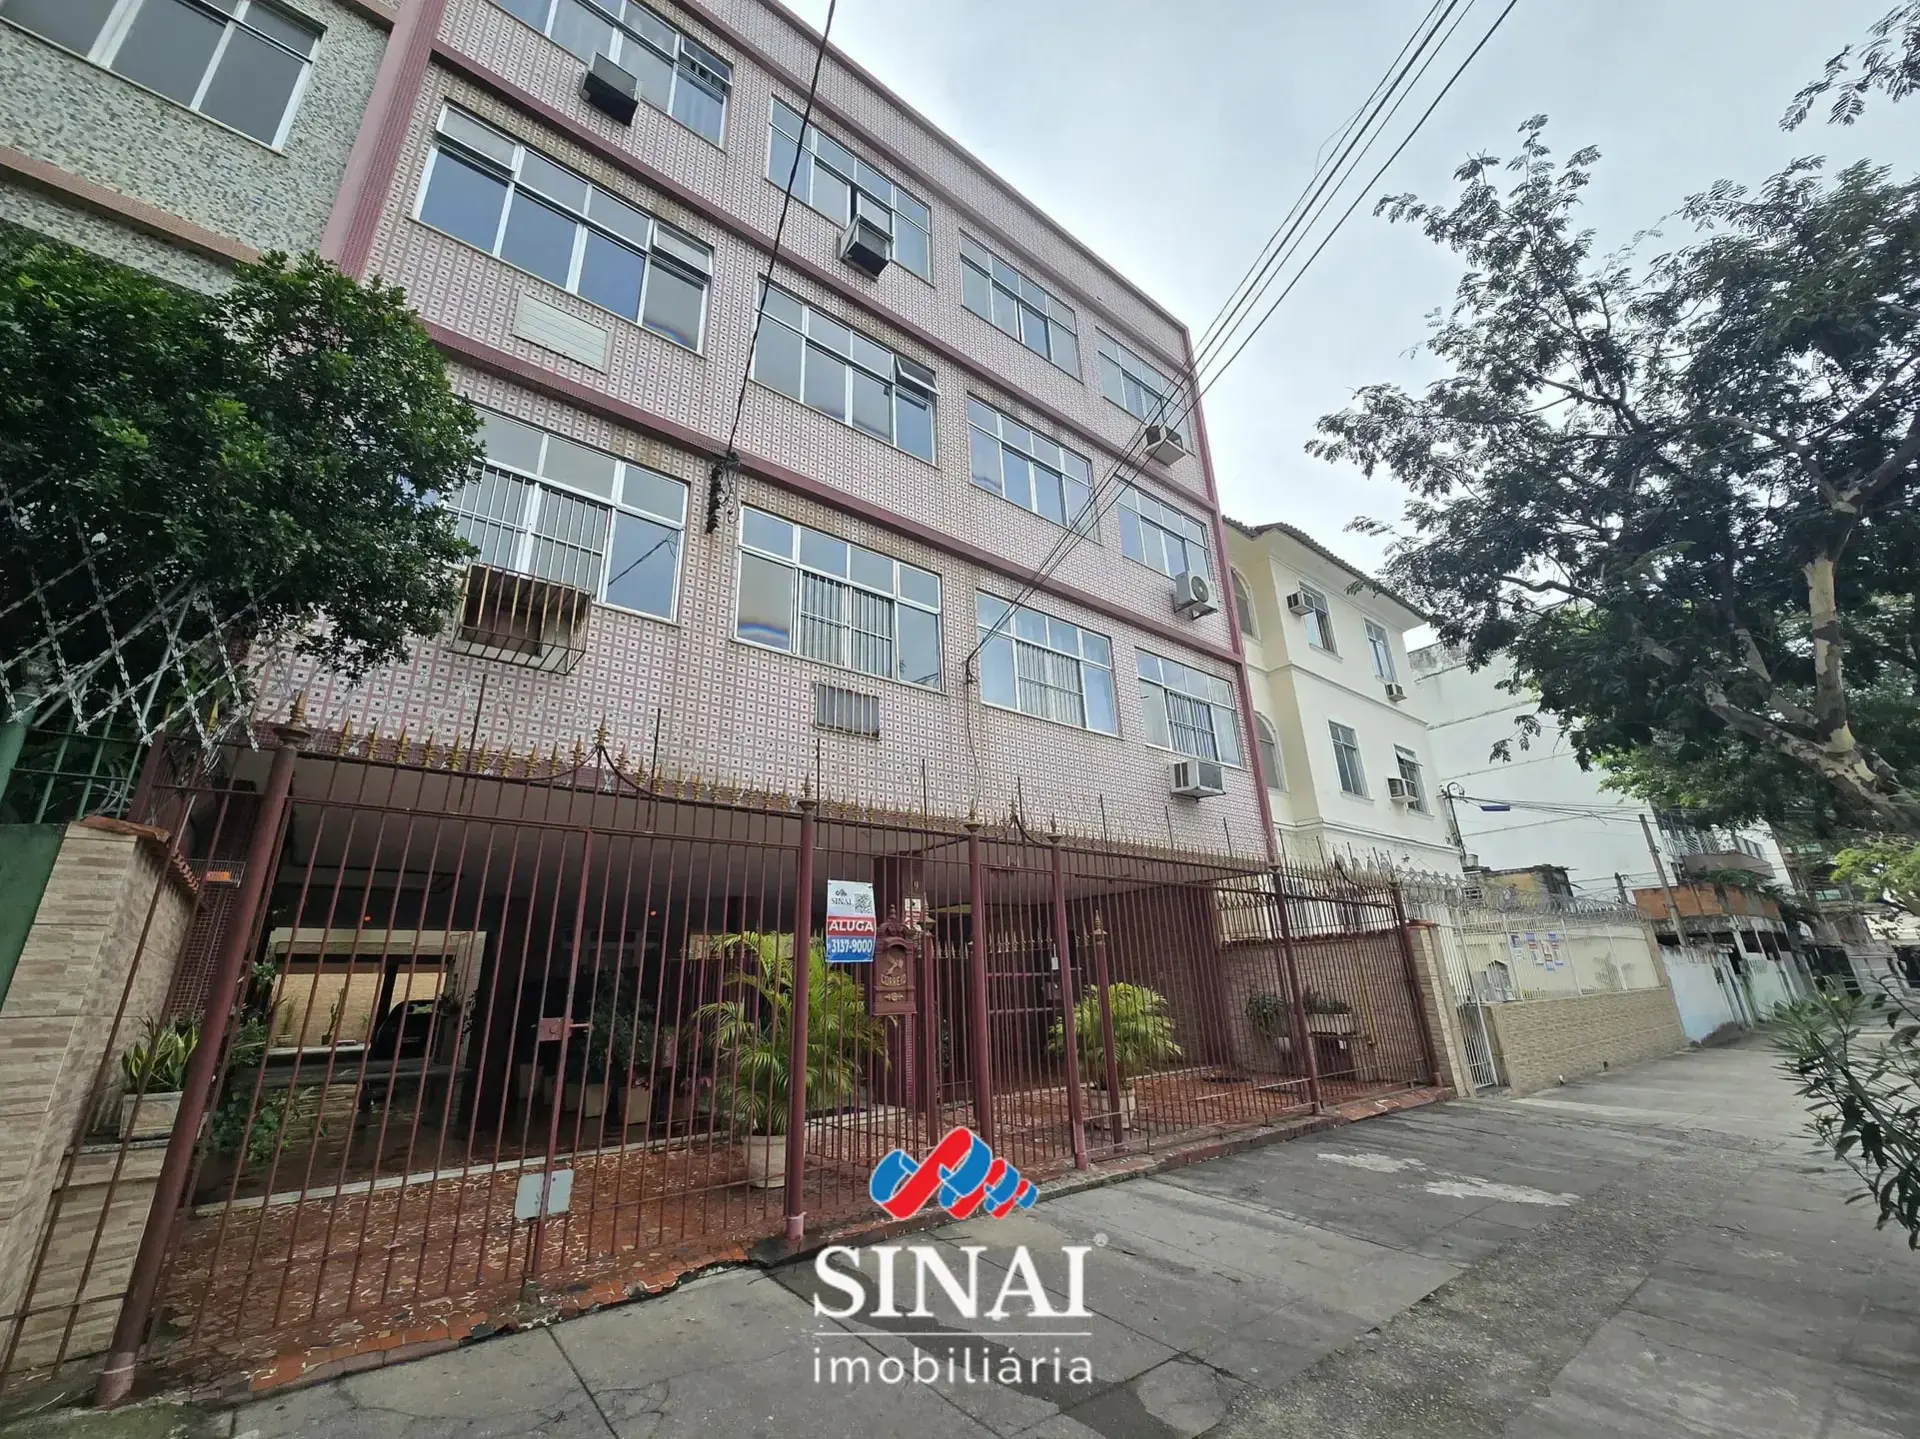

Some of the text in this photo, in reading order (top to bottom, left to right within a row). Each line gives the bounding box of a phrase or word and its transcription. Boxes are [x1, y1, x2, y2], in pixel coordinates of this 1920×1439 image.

[831, 897, 852, 905] SINAI
[829, 919, 874, 932] ALUGA
[831, 938, 873, 953] 3137-9000
